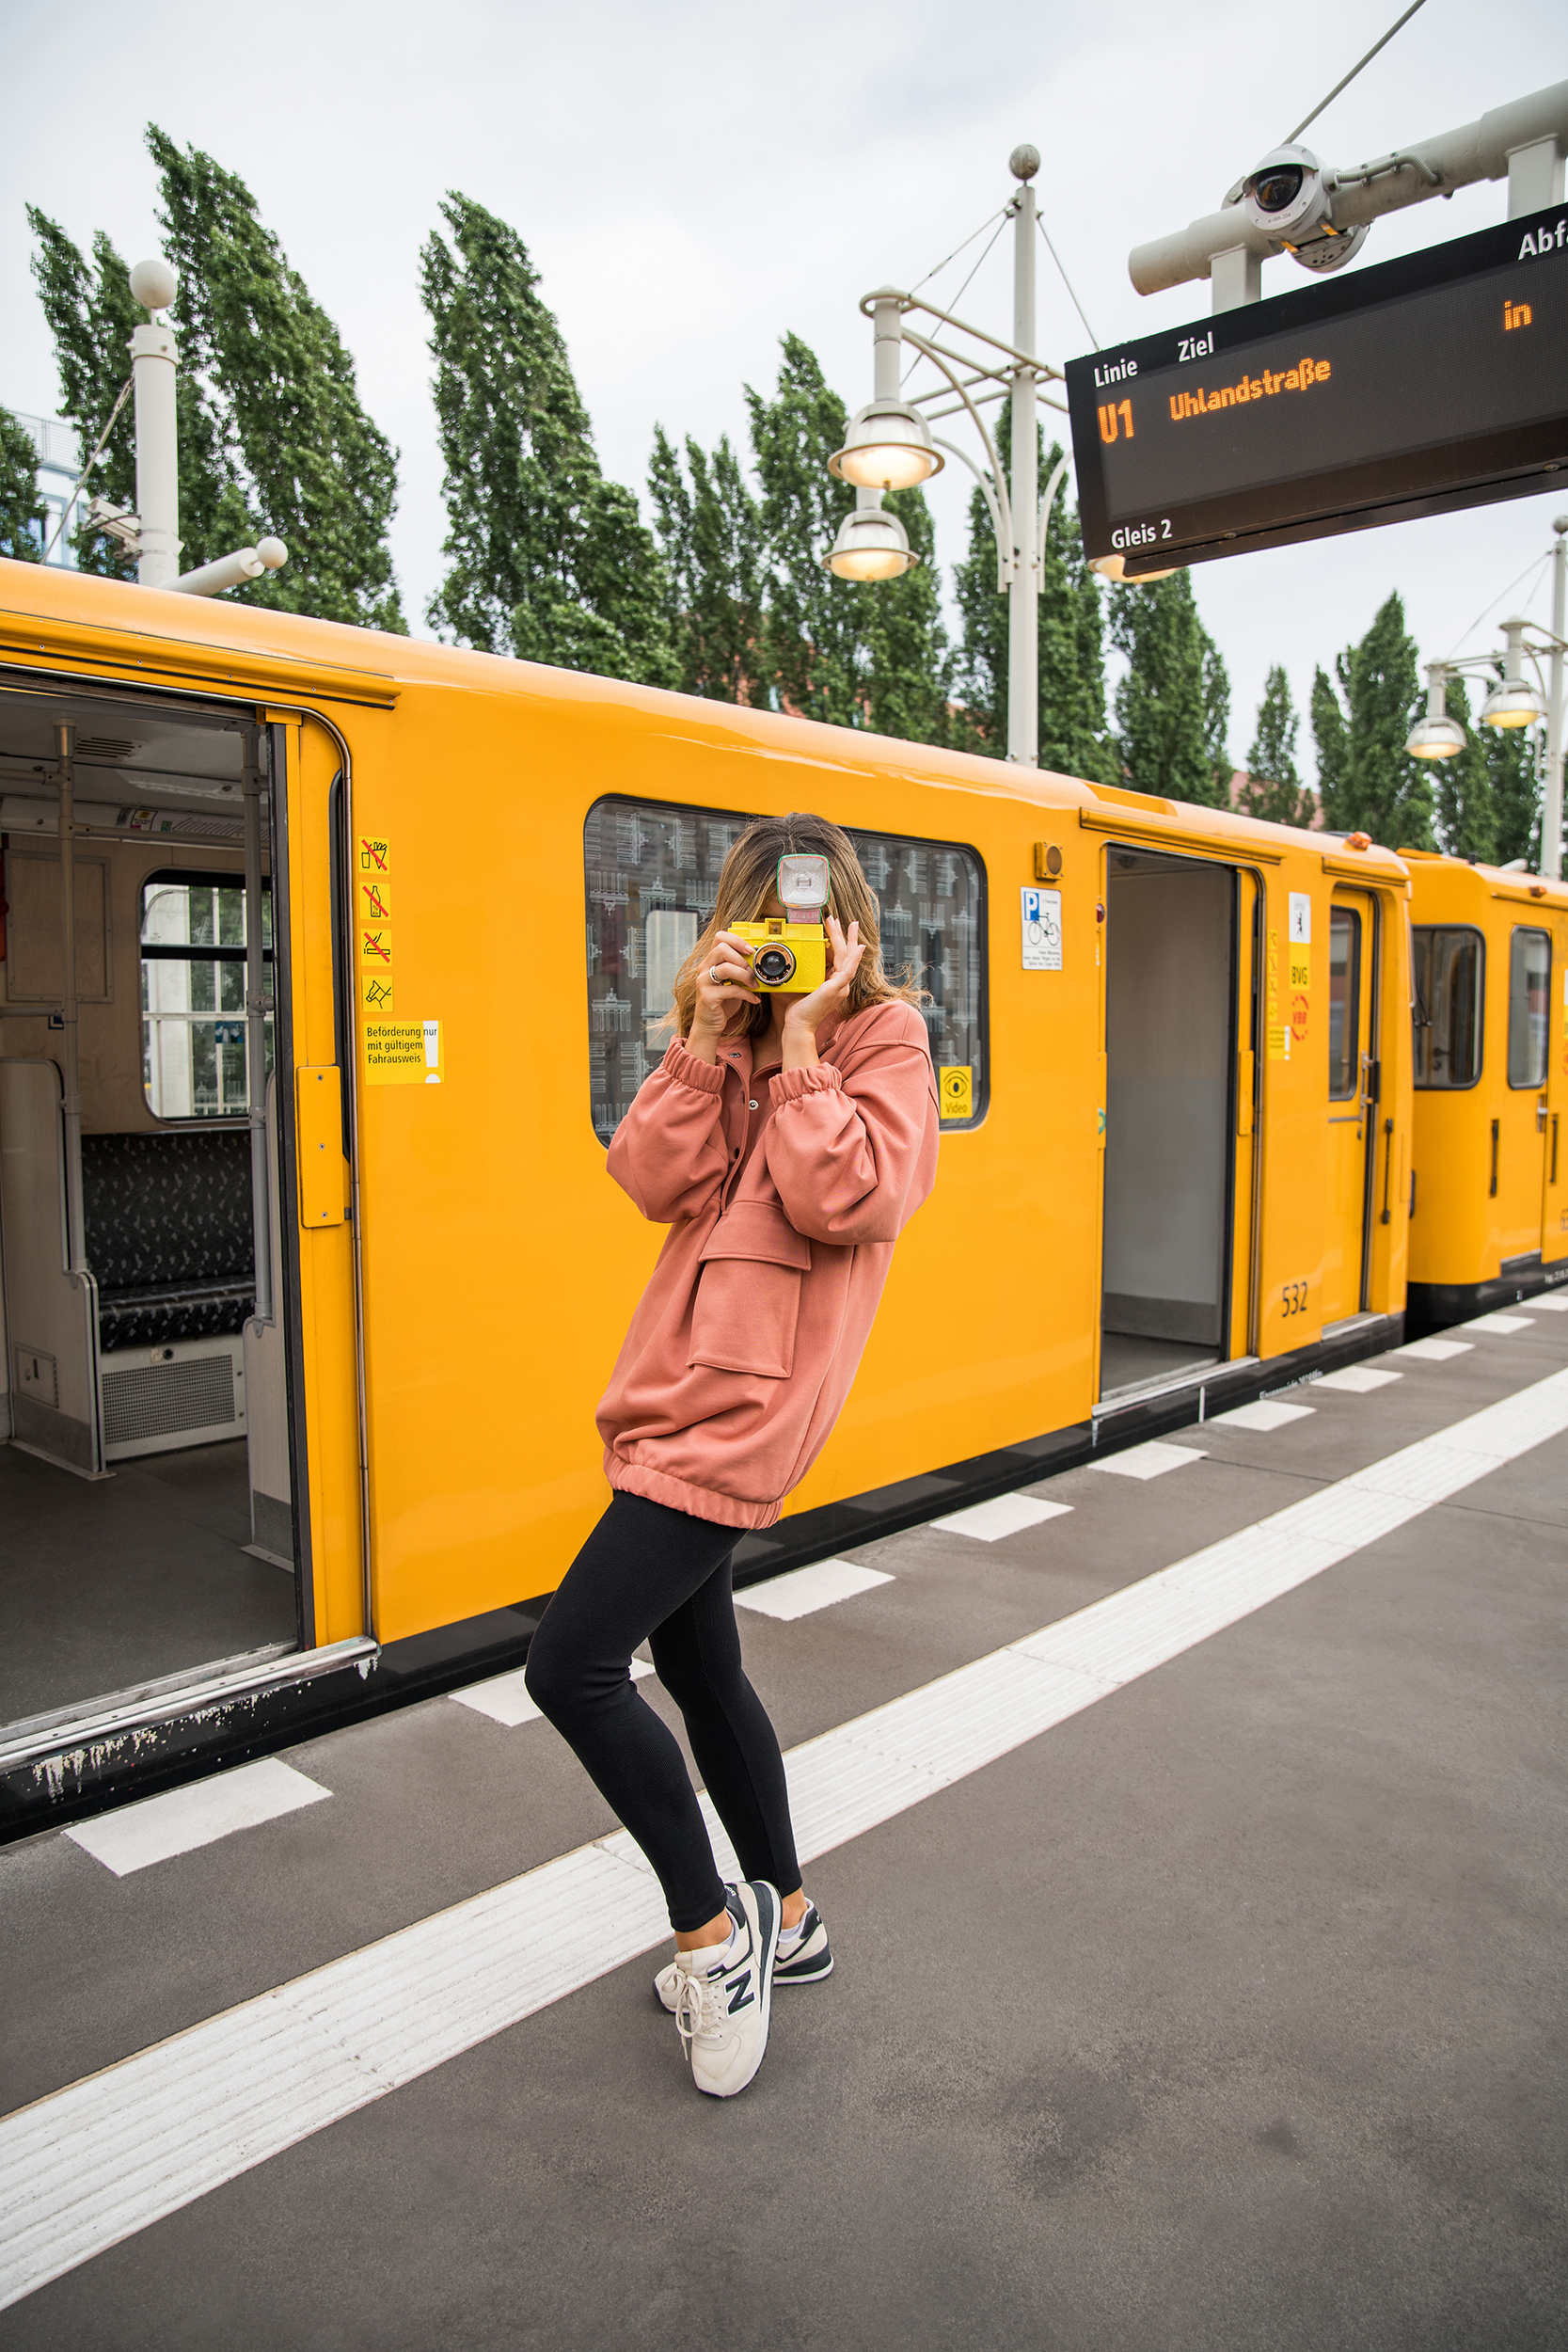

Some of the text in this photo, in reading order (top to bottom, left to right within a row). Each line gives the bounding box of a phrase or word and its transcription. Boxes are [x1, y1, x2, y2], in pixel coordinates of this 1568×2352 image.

[1094, 218, 1568, 388] Linie Ziel Abf
[1098, 300, 1531, 443] U1 Uhlandstraße in
[1111, 518, 1173, 548] Gleis 2
[1025, 892, 1038, 920] P
[1291, 966, 1307, 985] BVG
[1292, 1011, 1307, 1025] VBB
[367, 1026, 421, 1039] Beförderung
[367, 1040, 423, 1052] mit gültigem
[368, 1053, 421, 1064] Fahrausweis
[945, 1102, 968, 1114] Video
[1282, 1281, 1307, 1318] 532
[725, 1969, 756, 2018] N
